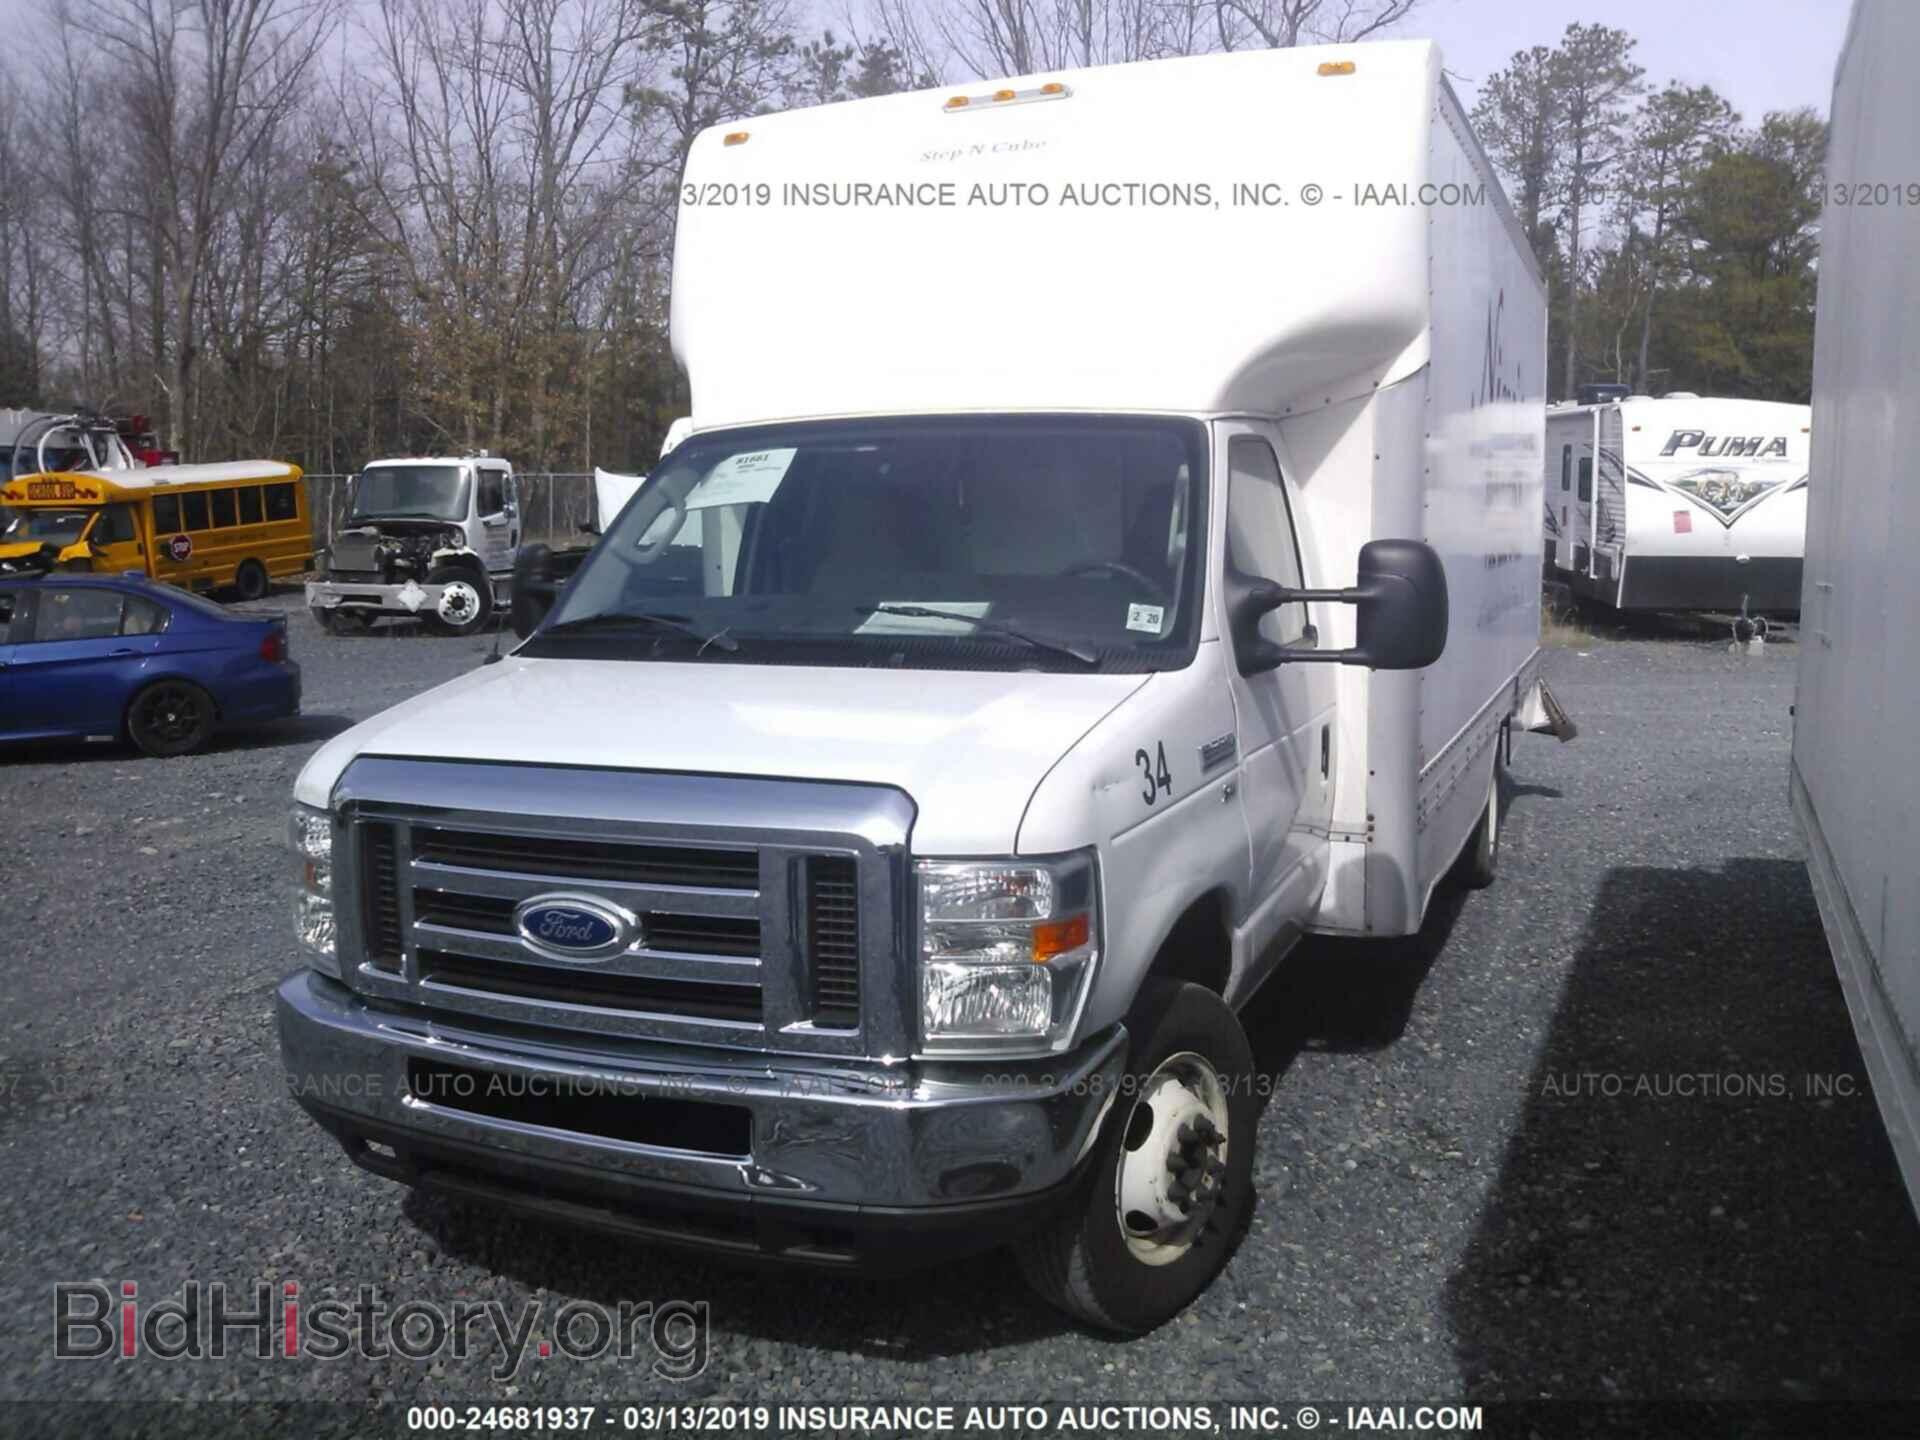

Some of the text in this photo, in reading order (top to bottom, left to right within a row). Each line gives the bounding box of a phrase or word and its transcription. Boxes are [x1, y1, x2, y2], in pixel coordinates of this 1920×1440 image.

[1658, 429, 1787, 457] PUMA
[1135, 740, 1172, 806] 34
[540, 911, 594, 940] Ford
